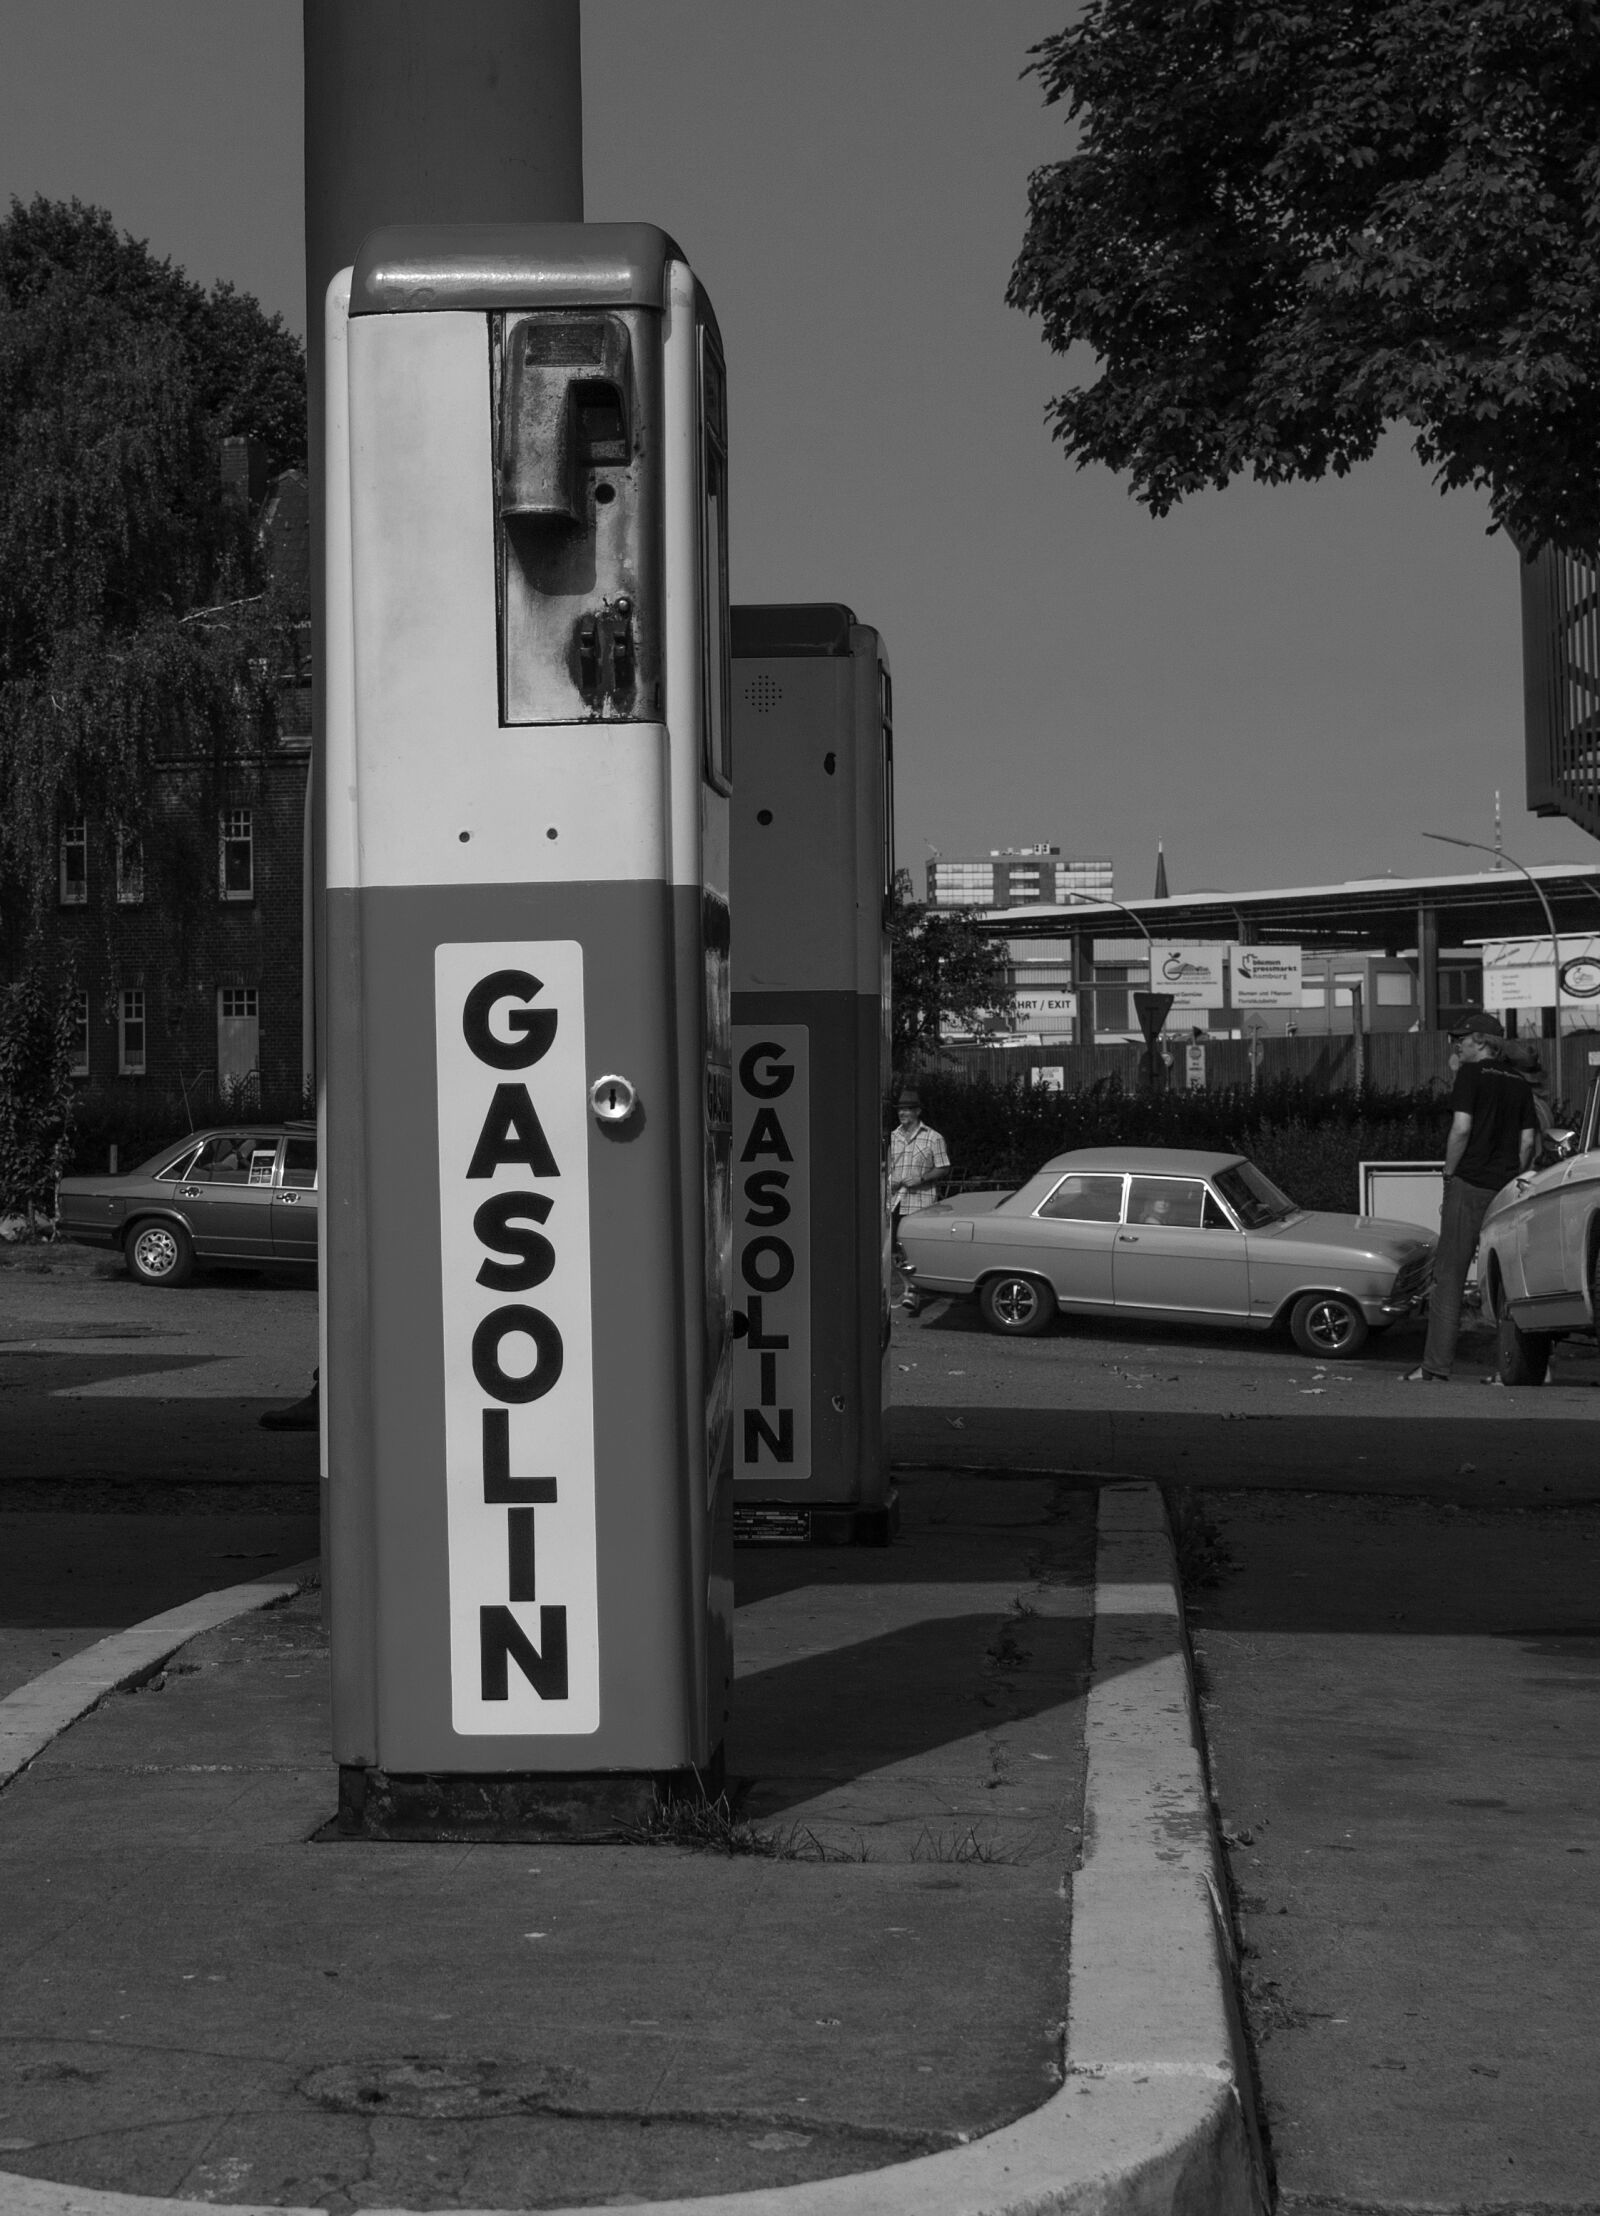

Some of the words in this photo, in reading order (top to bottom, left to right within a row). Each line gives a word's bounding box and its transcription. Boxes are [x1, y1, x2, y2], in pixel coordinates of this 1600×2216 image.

[1048, 1000, 1071, 1009] EXIT
[462, 969, 569, 1701] GASOLIN
[738, 1041, 795, 1464] GASOLIN
